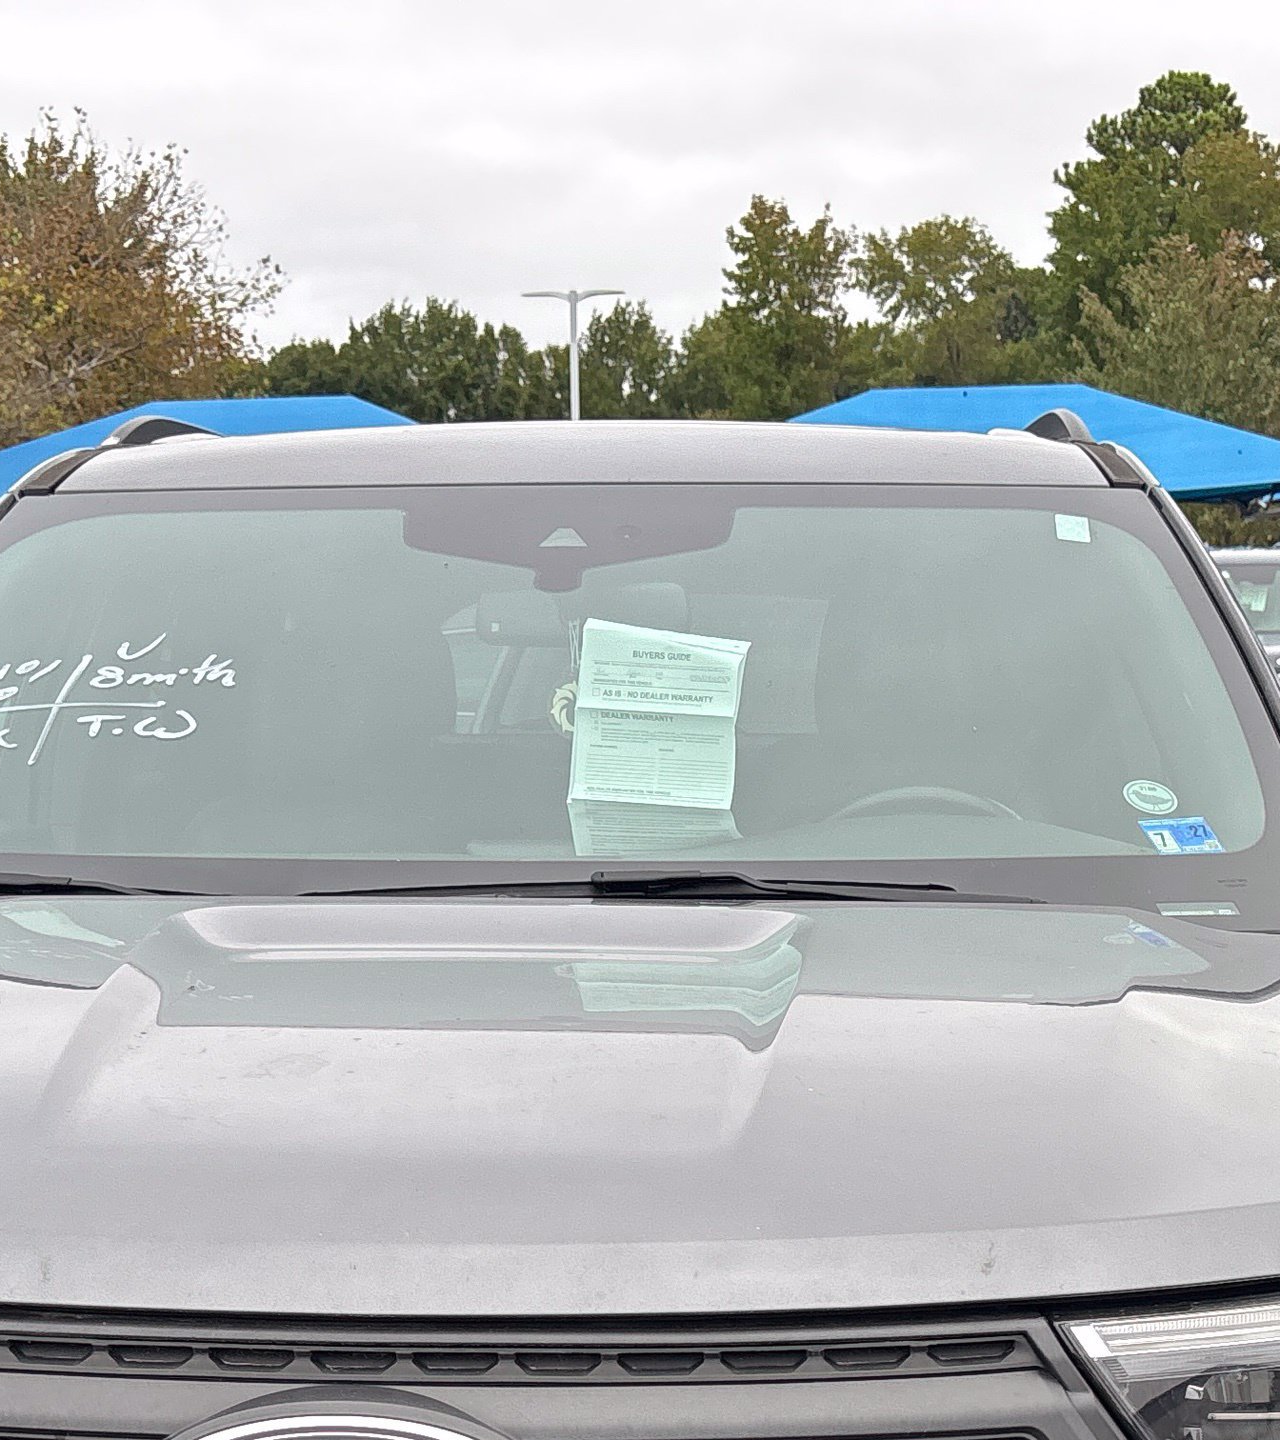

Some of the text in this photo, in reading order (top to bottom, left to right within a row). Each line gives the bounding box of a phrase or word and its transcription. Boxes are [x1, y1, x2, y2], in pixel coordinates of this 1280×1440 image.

[632, 651, 691, 661] BUYERS GUIDE
[602, 689, 613, 697] AS
[627, 691, 639, 699] NO
[640, 691, 669, 701] DEALER
[671, 694, 713, 703] WARRANTY
[601, 711, 674, 722] DEALER WARRANTY
[1190, 826, 1208, 837] 27
[1153, 833, 1166, 847] 7
